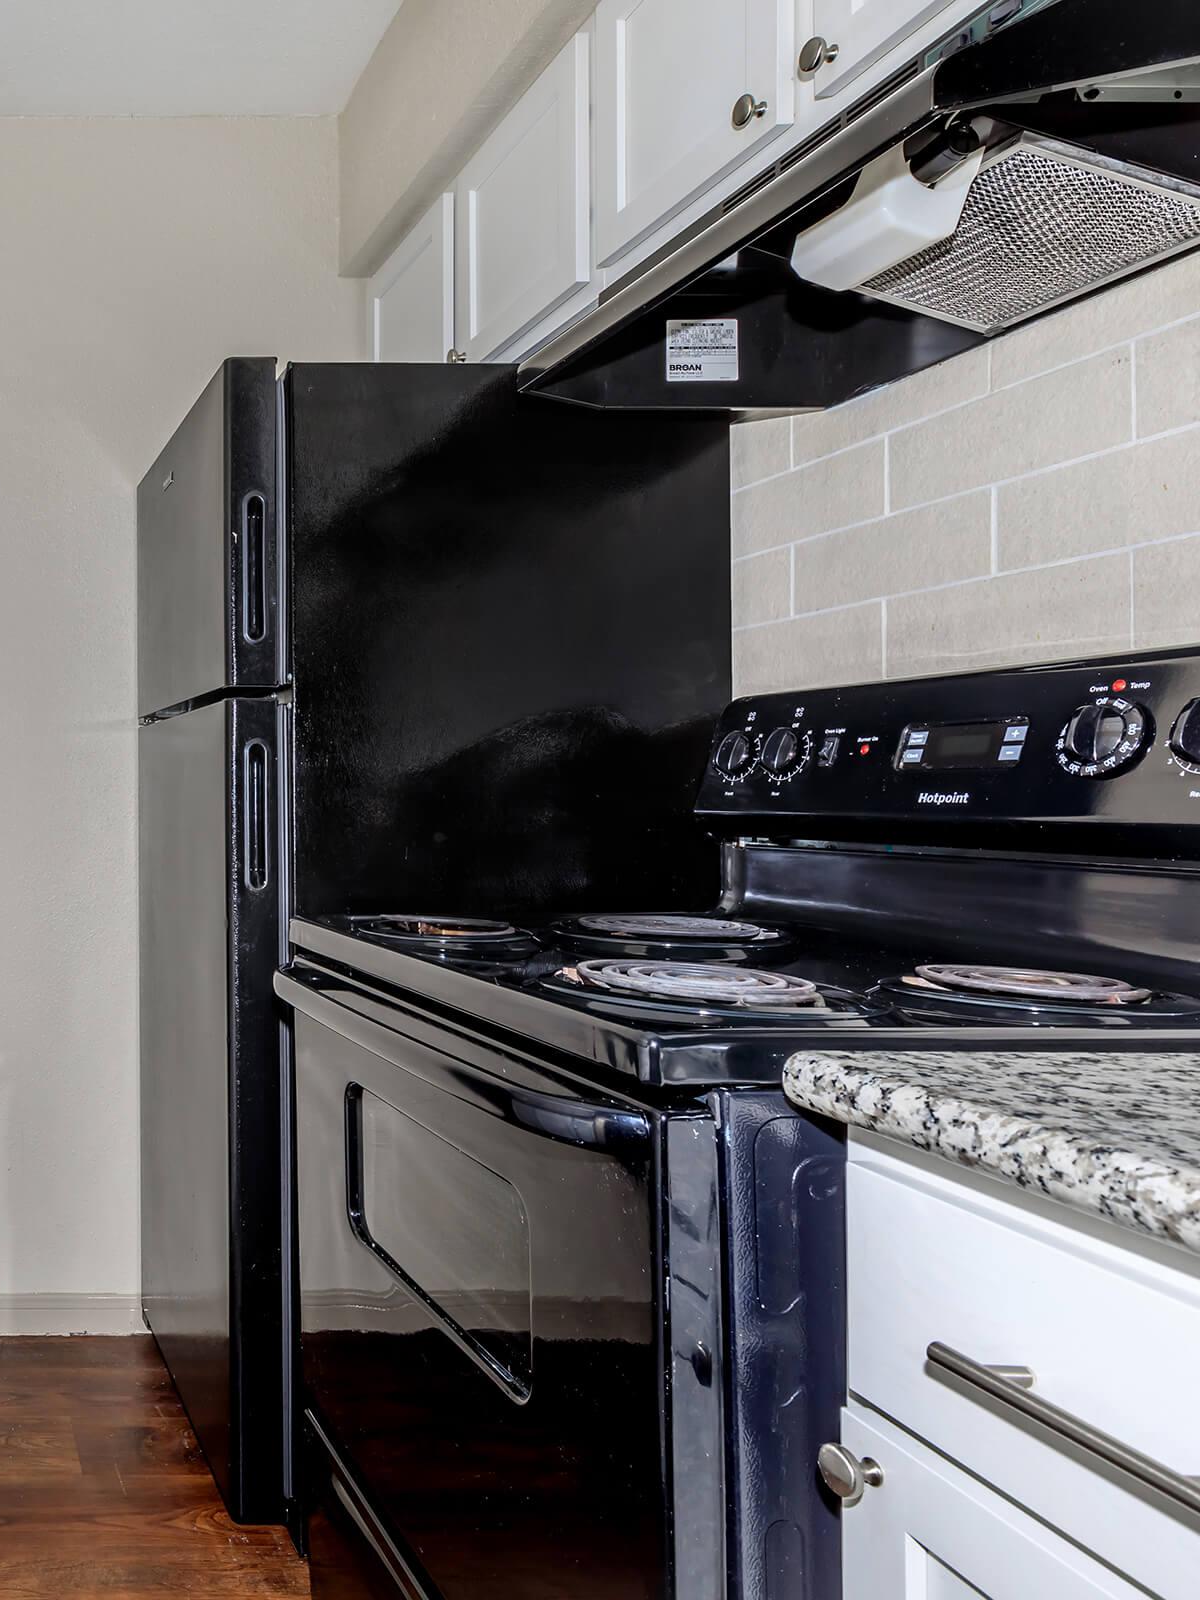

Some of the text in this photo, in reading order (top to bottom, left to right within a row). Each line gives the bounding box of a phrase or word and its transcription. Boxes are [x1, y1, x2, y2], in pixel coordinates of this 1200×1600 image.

[1089, 681, 1151, 693] Oven Temp
[918, 792, 969, 805] Hotpoint
